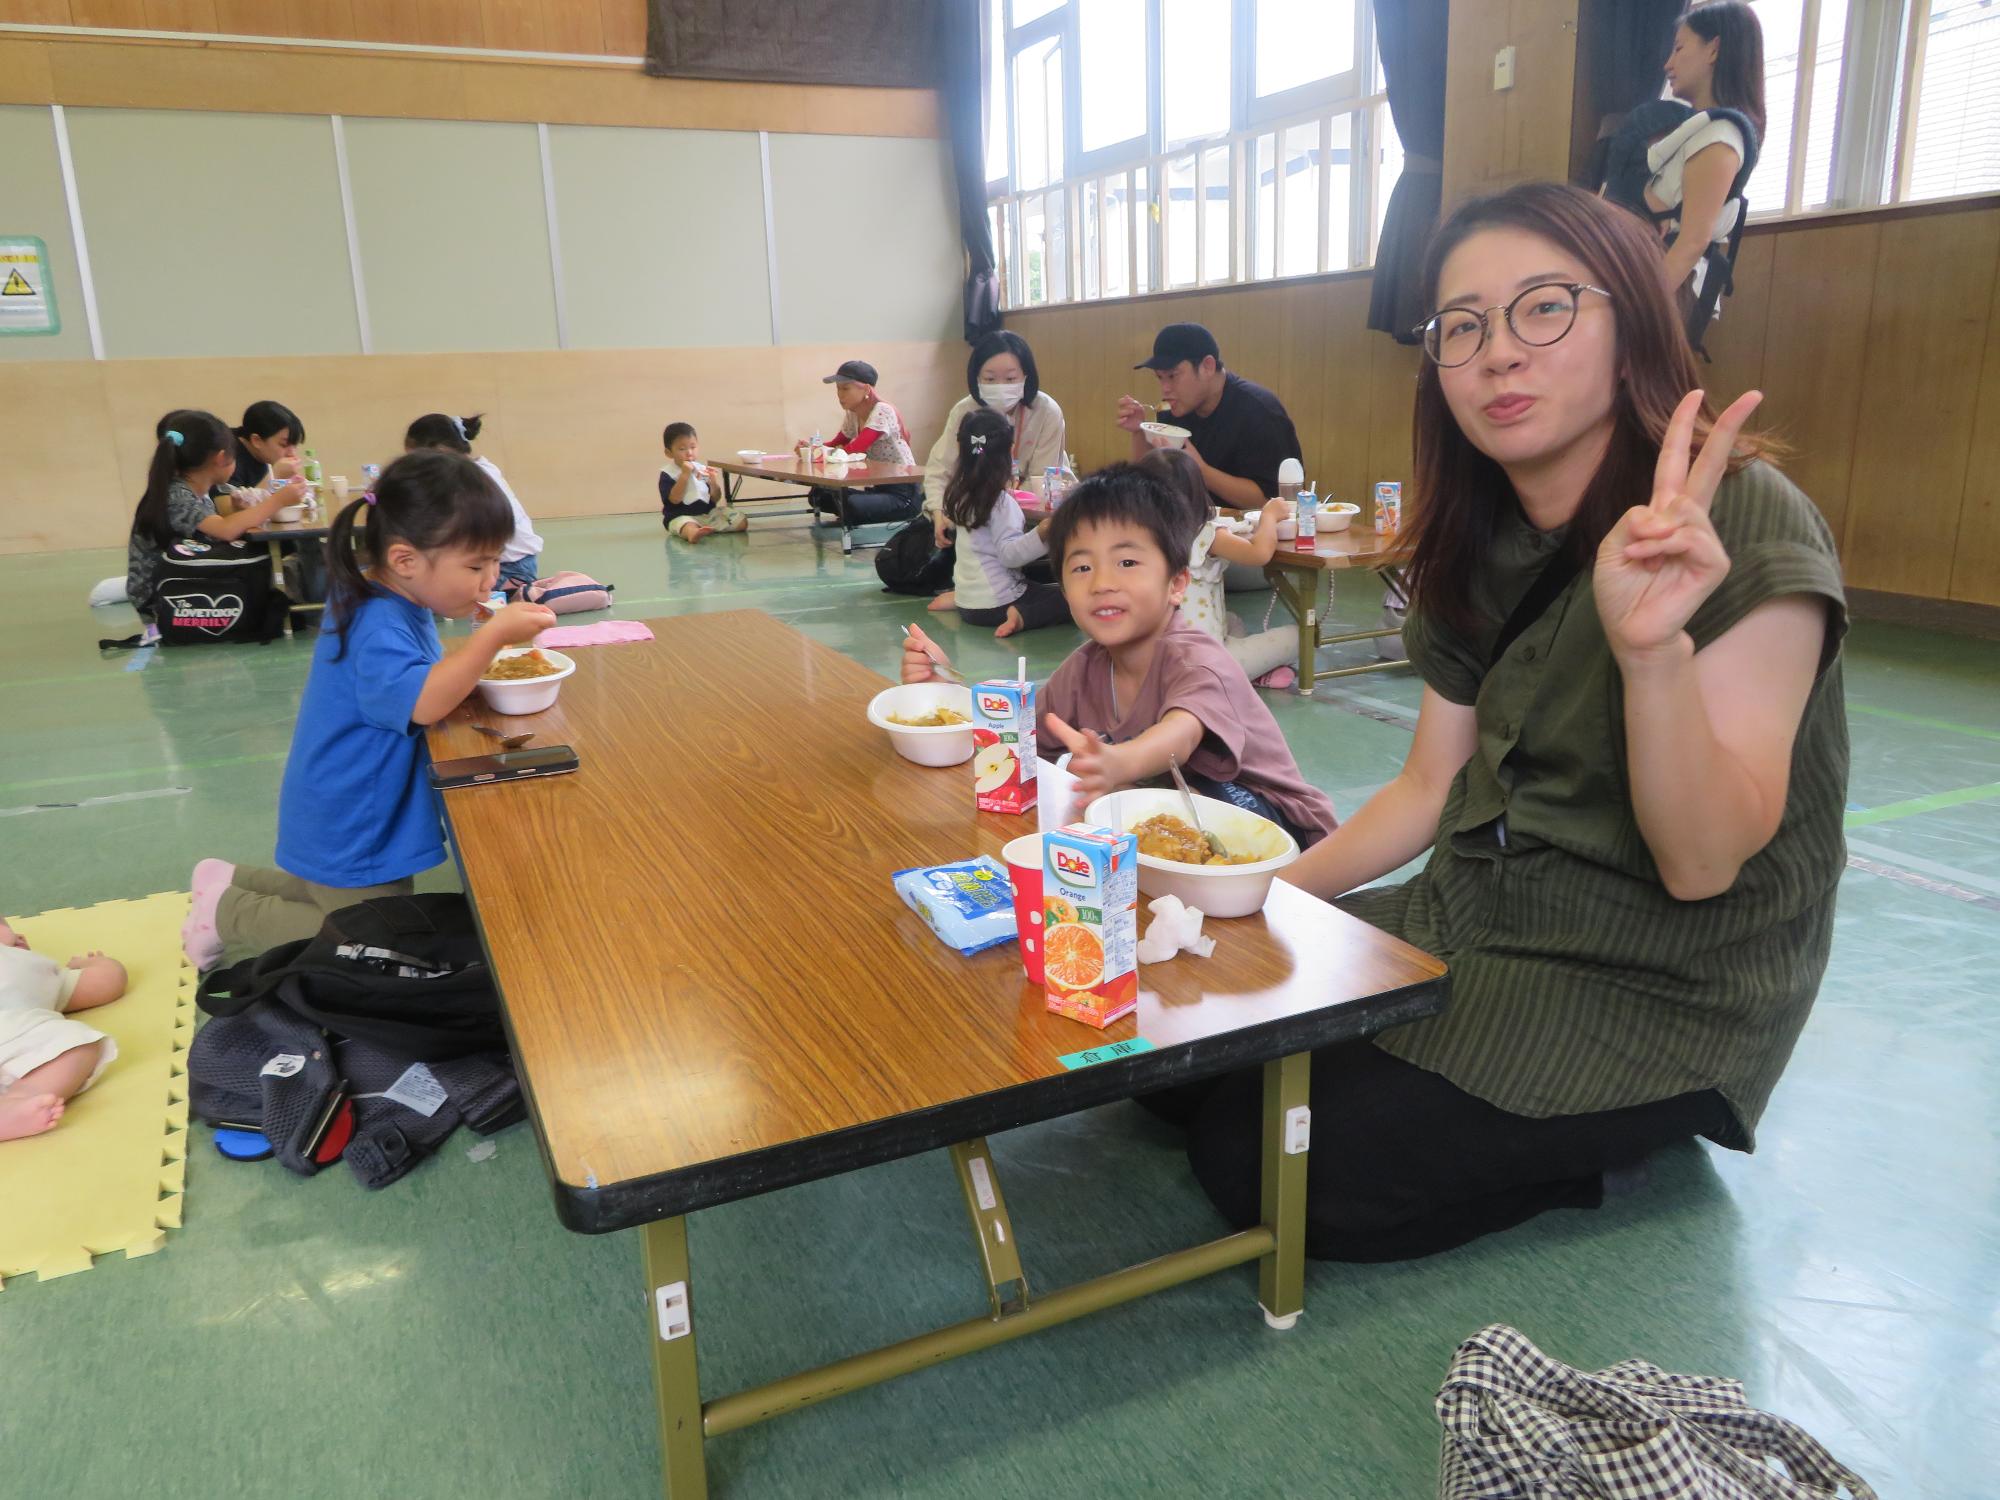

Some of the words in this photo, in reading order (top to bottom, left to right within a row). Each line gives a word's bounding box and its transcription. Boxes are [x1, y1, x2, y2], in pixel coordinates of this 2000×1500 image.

[173, 618, 230, 626] MERRILY
[983, 697, 1009, 710] Dole
[988, 721, 1004, 730] Apple
[1057, 851, 1090, 875] Dole
[1059, 887, 1087, 902] Orange
